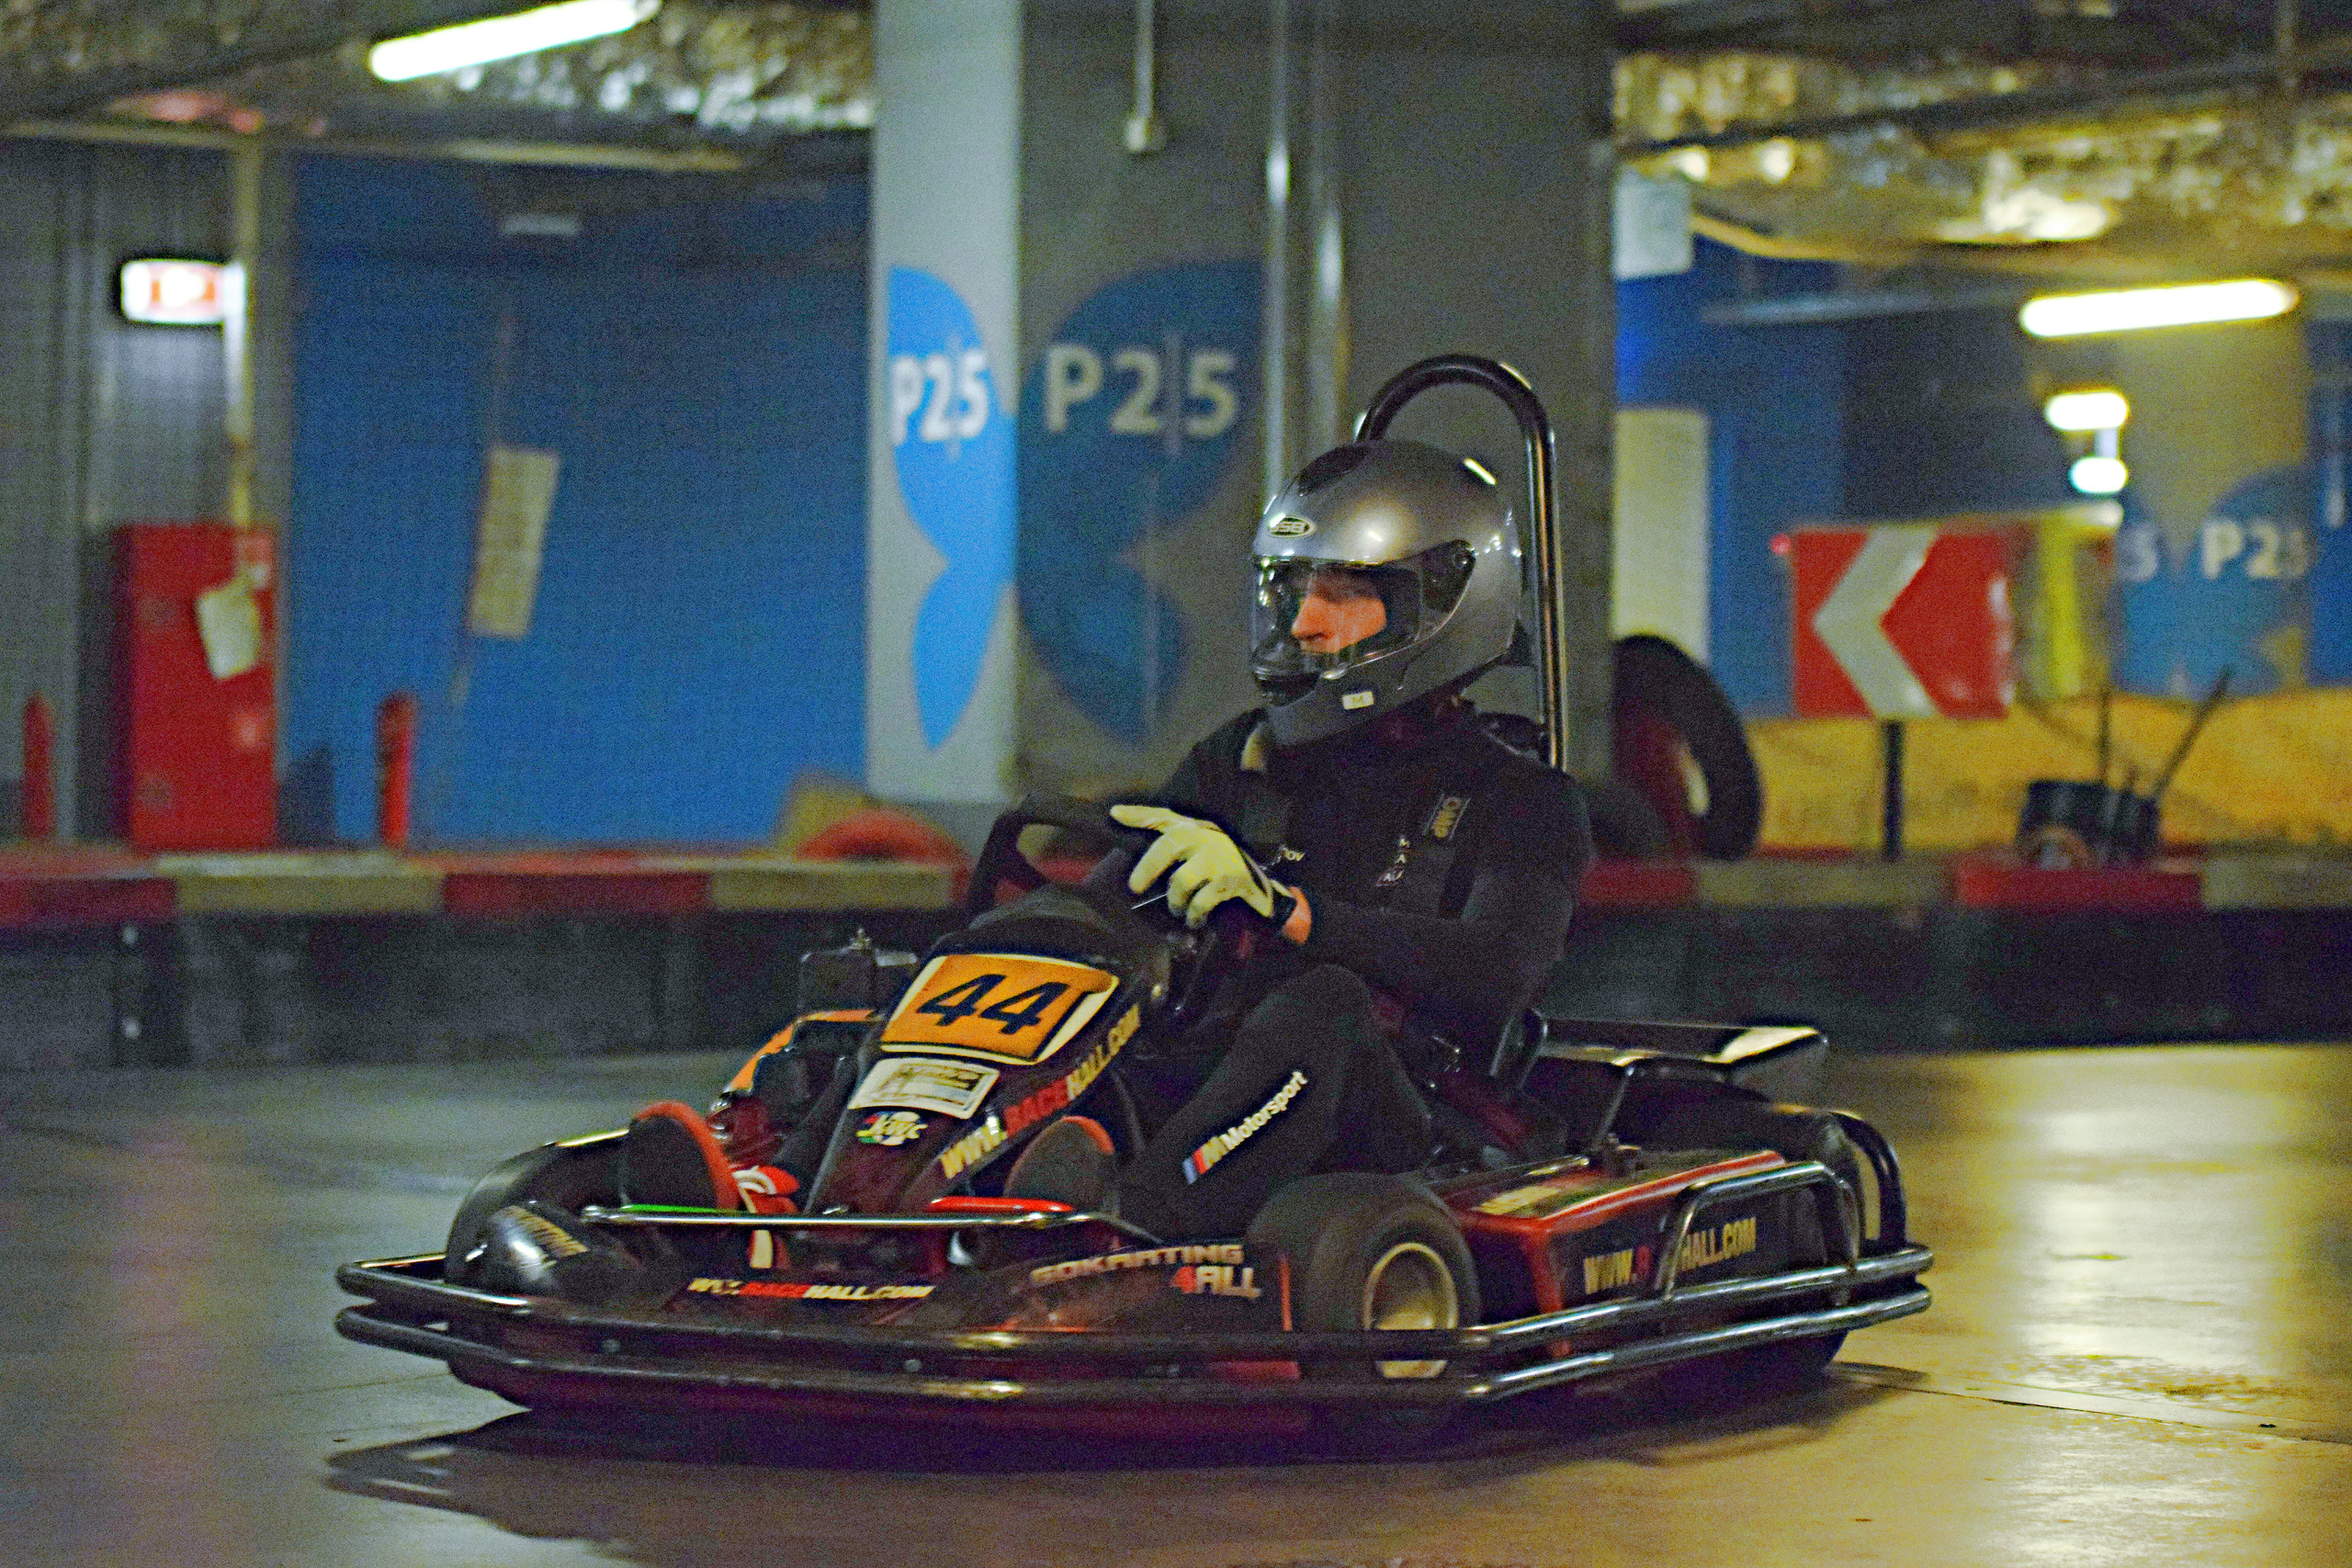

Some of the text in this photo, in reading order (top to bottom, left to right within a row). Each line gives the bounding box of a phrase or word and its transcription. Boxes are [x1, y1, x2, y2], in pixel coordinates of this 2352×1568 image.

[892, 348, 988, 447] P25
[1046, 343, 1238, 437] P25
[916, 975, 1070, 1034] 44
[1219, 1071, 1308, 1150] Motorsport
